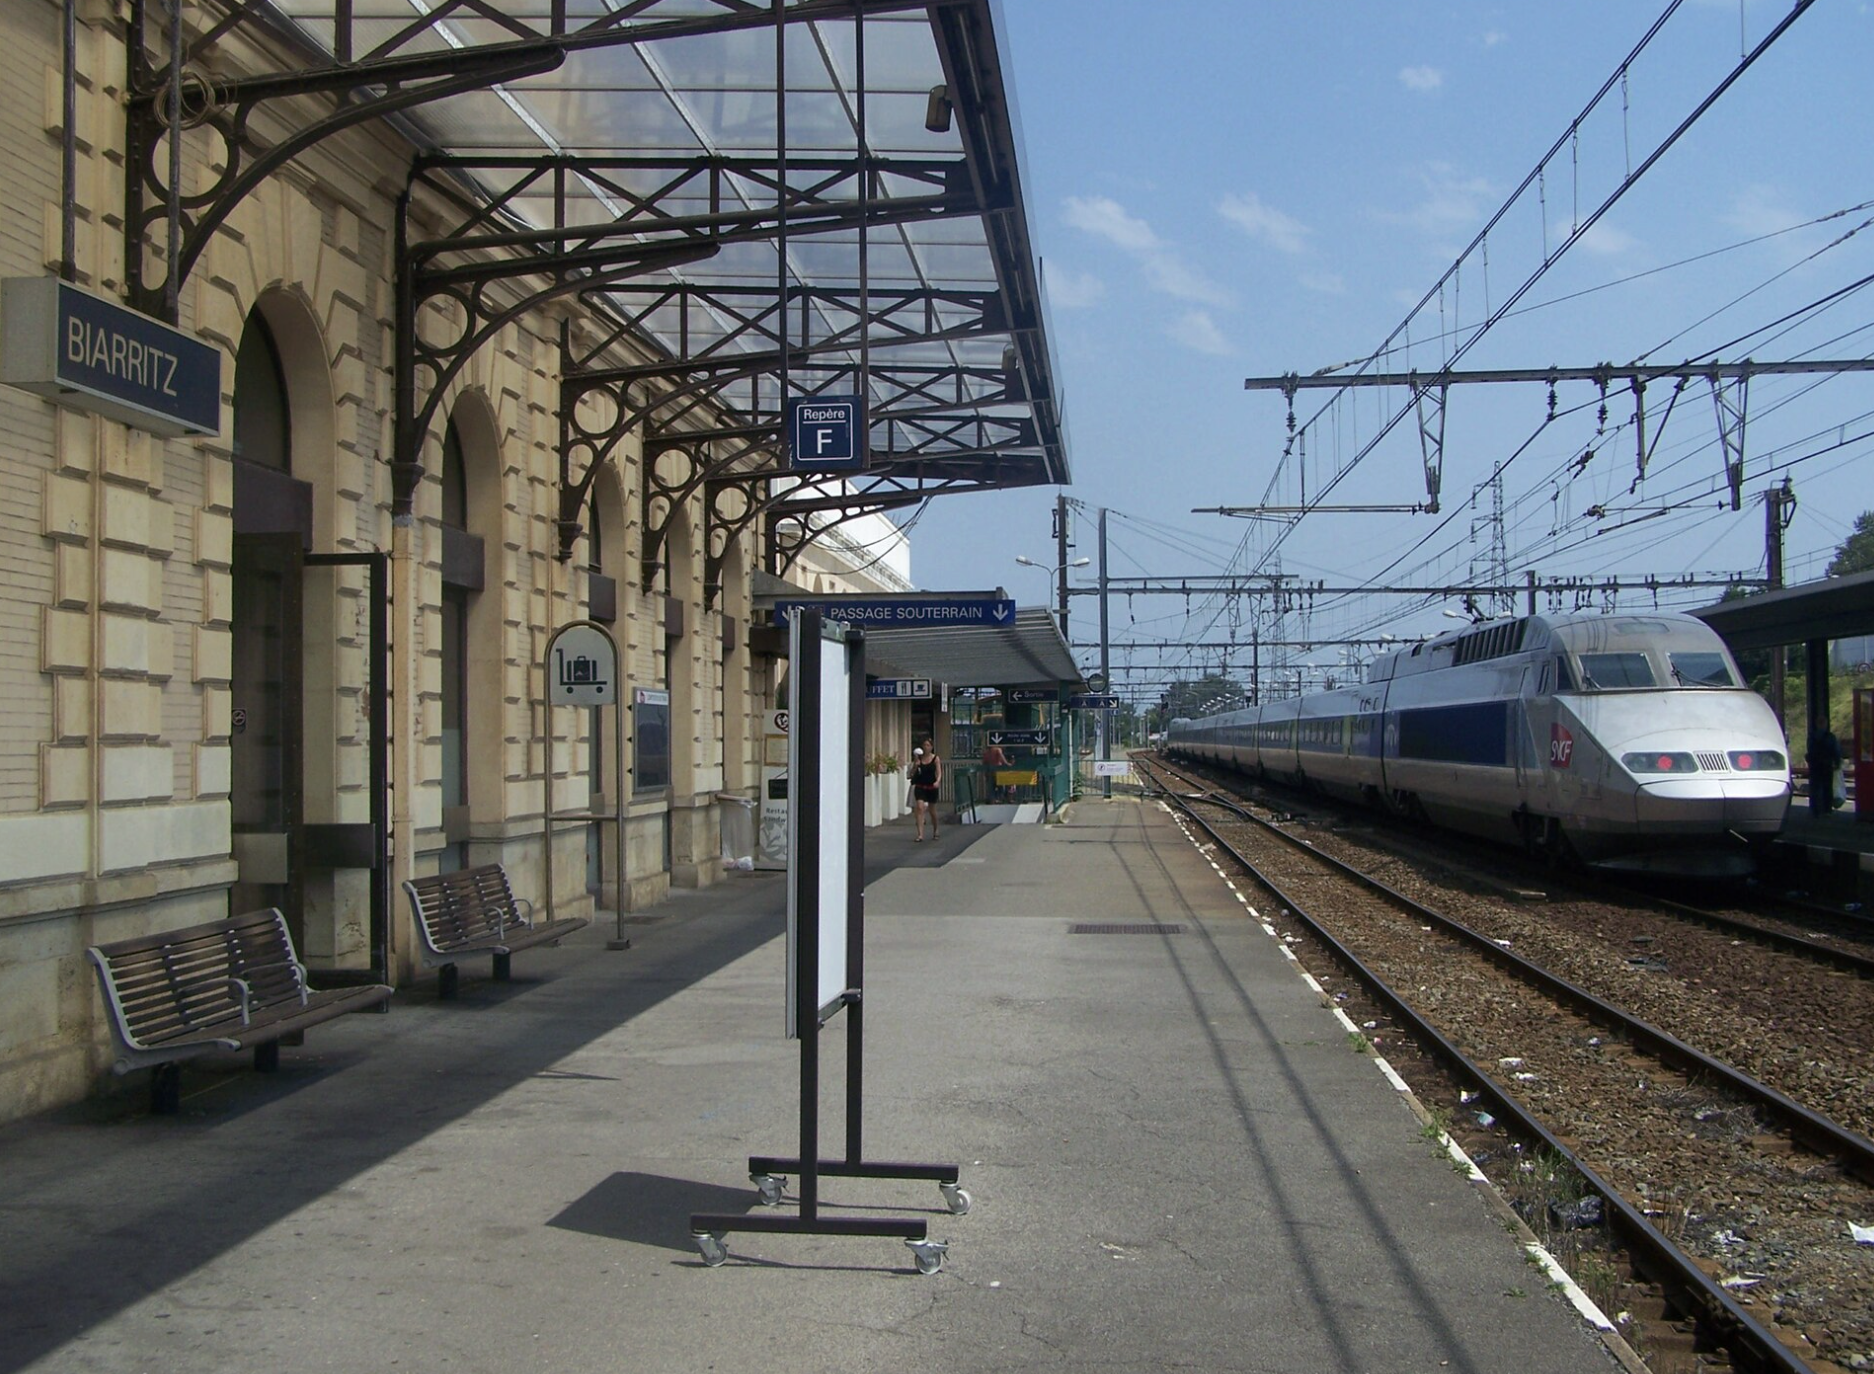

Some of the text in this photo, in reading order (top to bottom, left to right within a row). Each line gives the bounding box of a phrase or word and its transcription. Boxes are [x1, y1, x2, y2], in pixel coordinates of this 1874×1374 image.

[68, 315, 178, 397] BIARRITZ
[803, 408, 845, 421] Repère
[817, 429, 832, 454] F
[830, 607, 983, 619] PASSAGE SOUTERRAIN
[867, 684, 895, 695] FFET
[1550, 740, 1572, 761] SNCF
